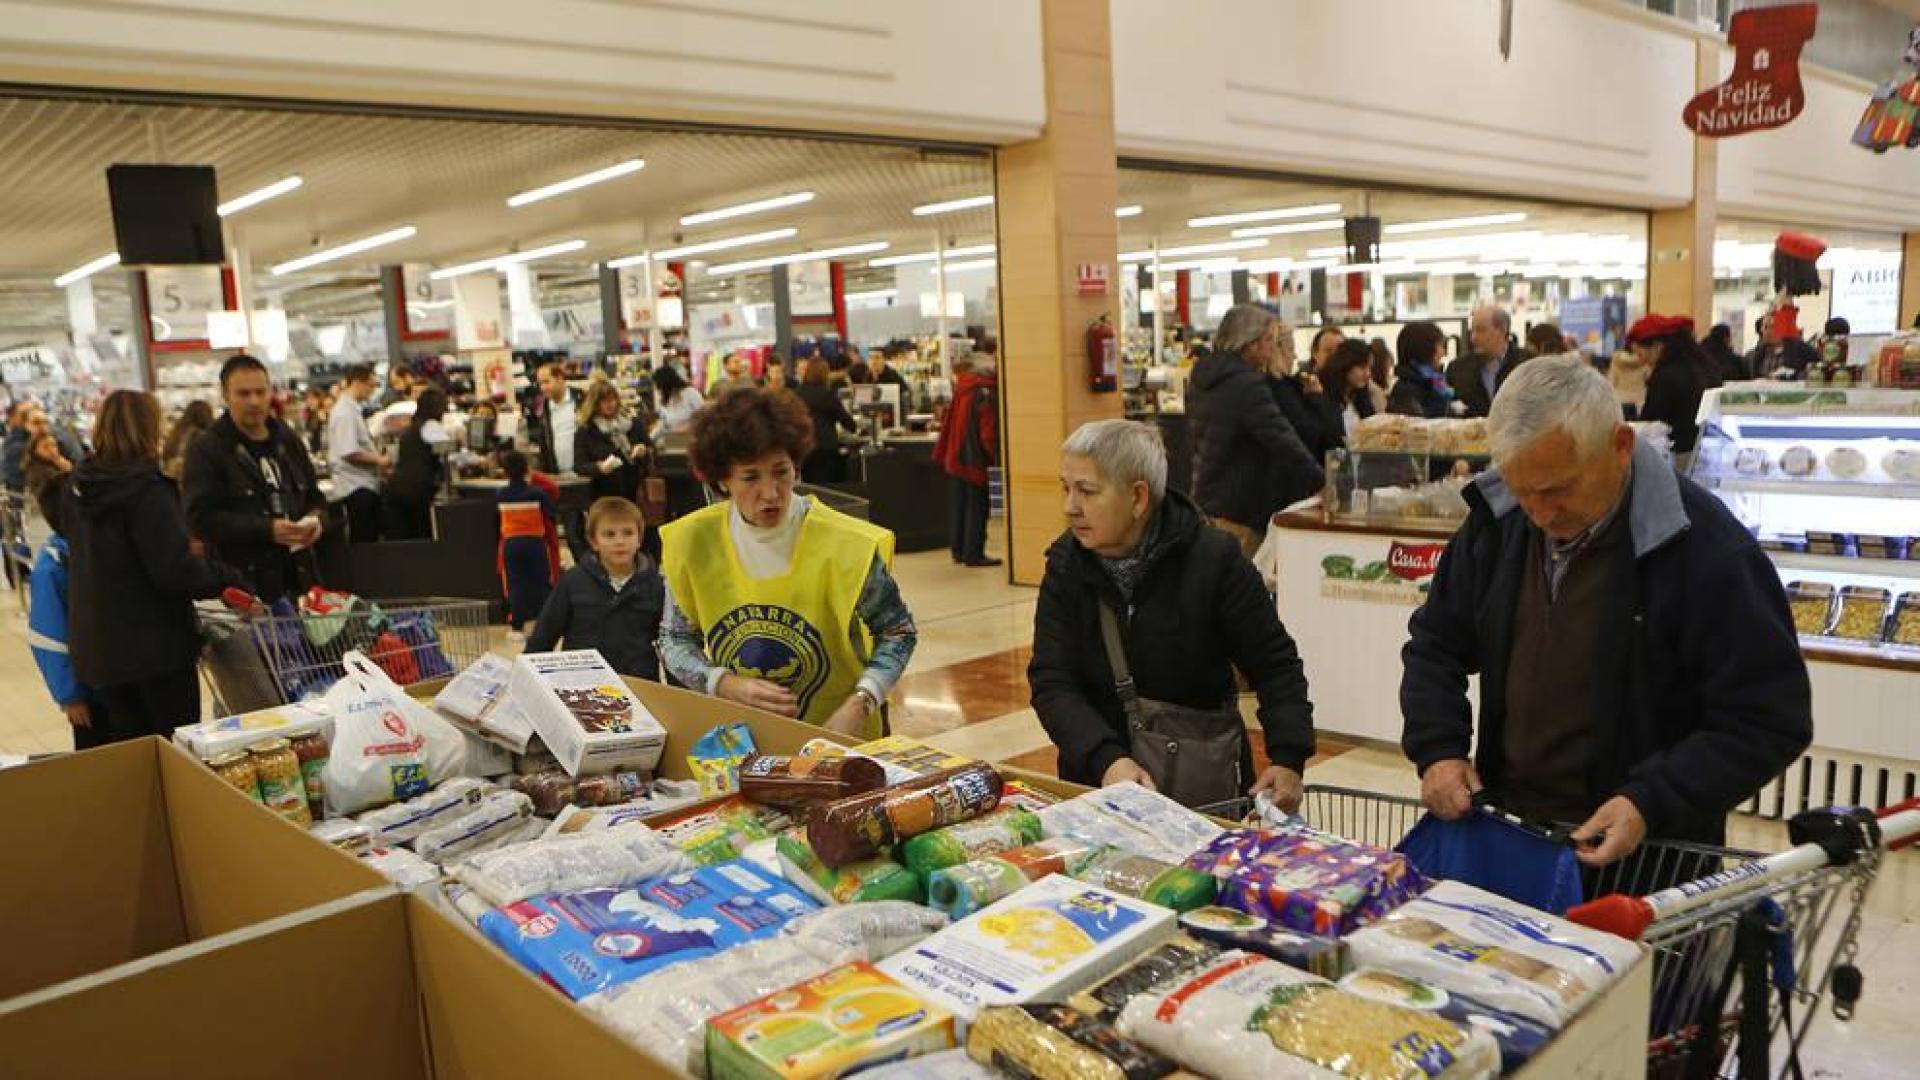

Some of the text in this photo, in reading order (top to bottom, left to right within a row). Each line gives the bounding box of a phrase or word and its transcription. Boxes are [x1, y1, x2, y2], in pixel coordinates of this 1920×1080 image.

[1717, 80, 1772, 106] Feliz
[1696, 99, 1791, 133] Navidad
[1391, 546, 1423, 568] Casa
[723, 605, 806, 633] NAVARRA
